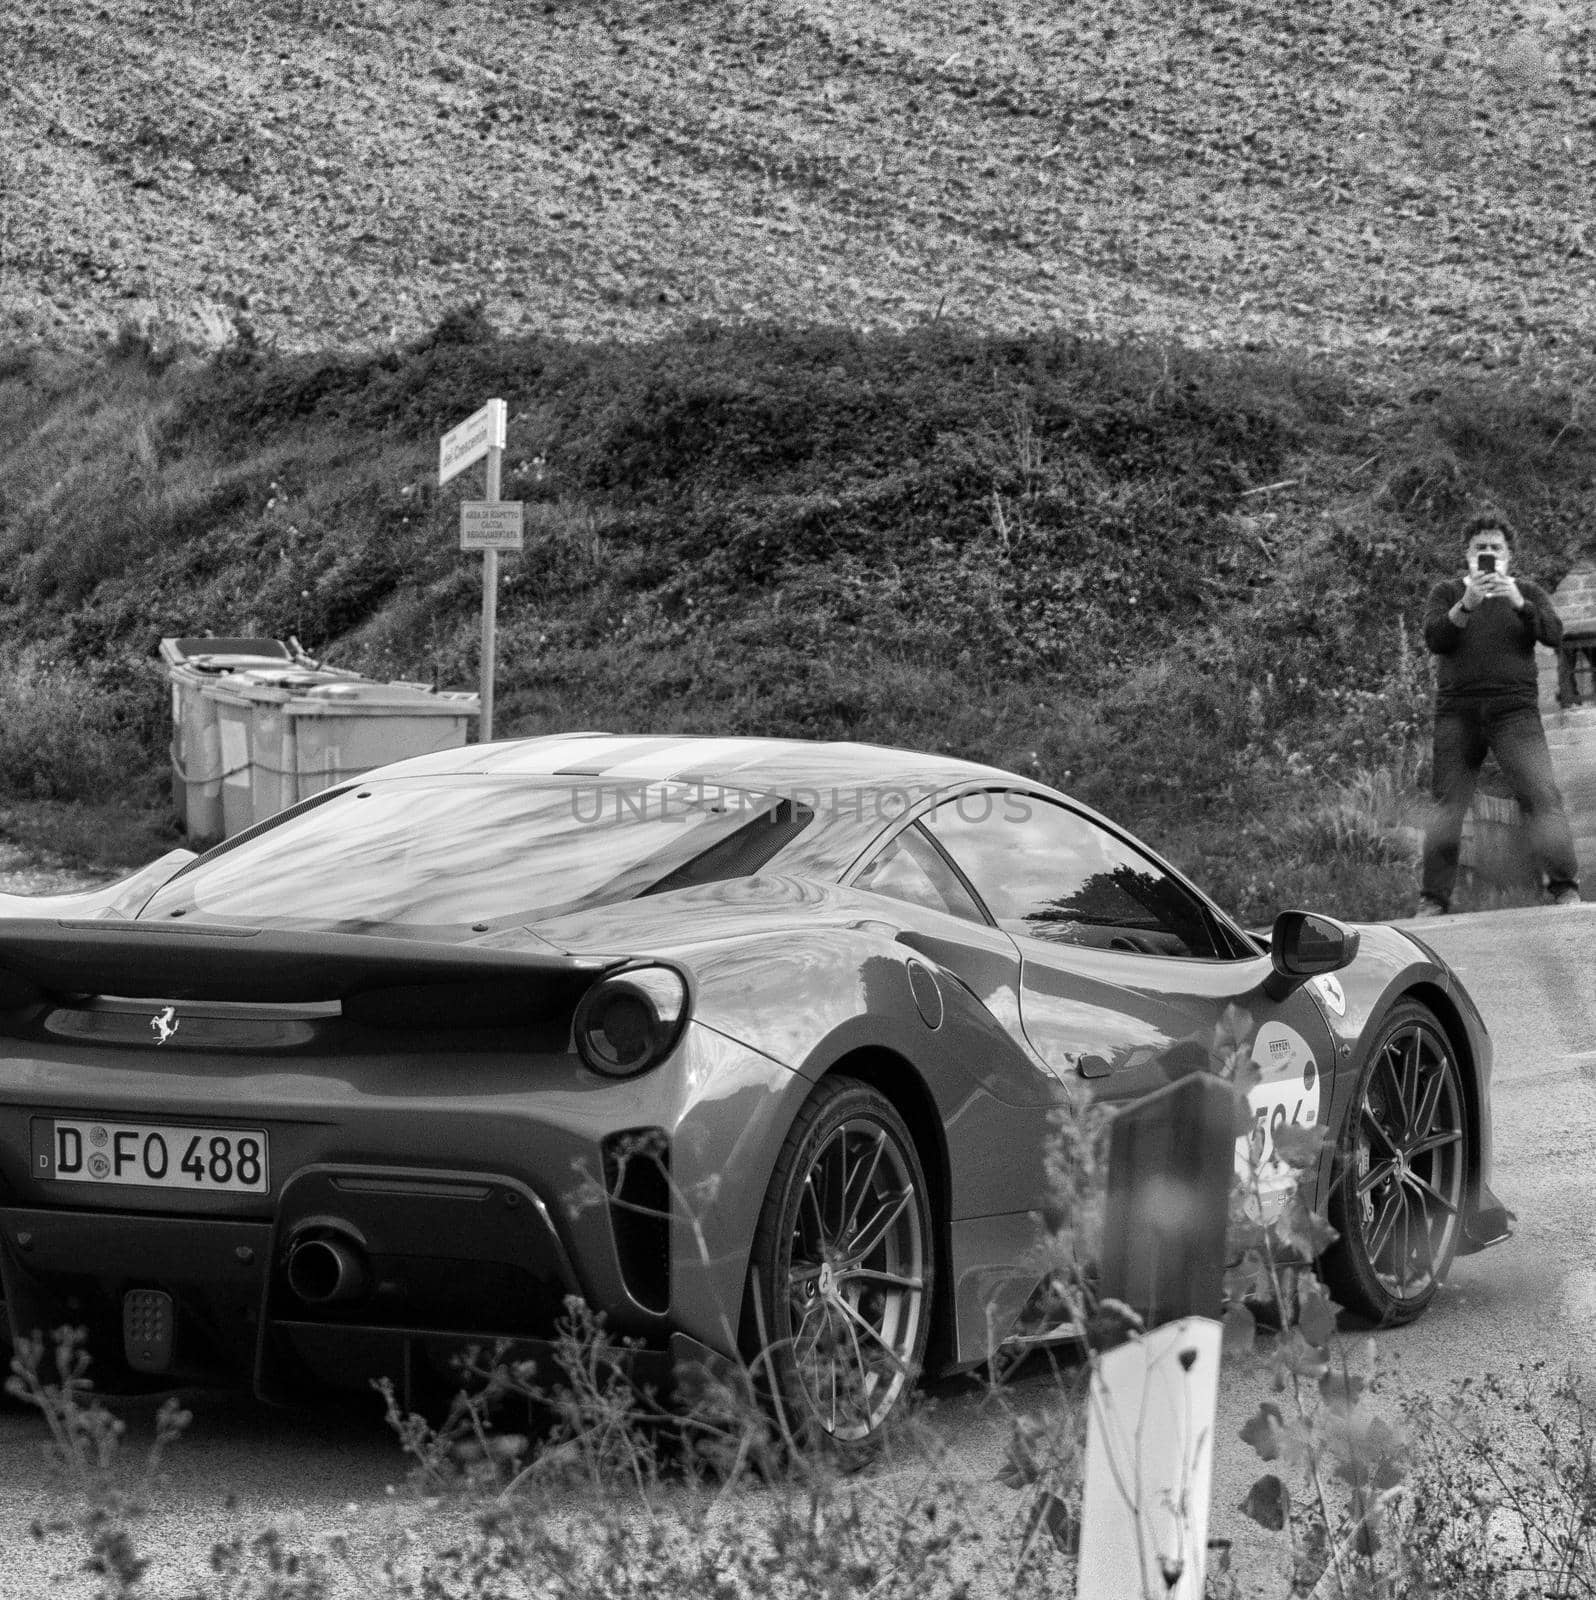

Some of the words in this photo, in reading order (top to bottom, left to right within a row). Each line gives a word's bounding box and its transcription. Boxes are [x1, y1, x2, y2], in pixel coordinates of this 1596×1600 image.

[39, 1154, 49, 1168] D
[56, 1127, 83, 1173] D
[113, 1131, 168, 1179] FO
[180, 1135, 262, 1185] 488
